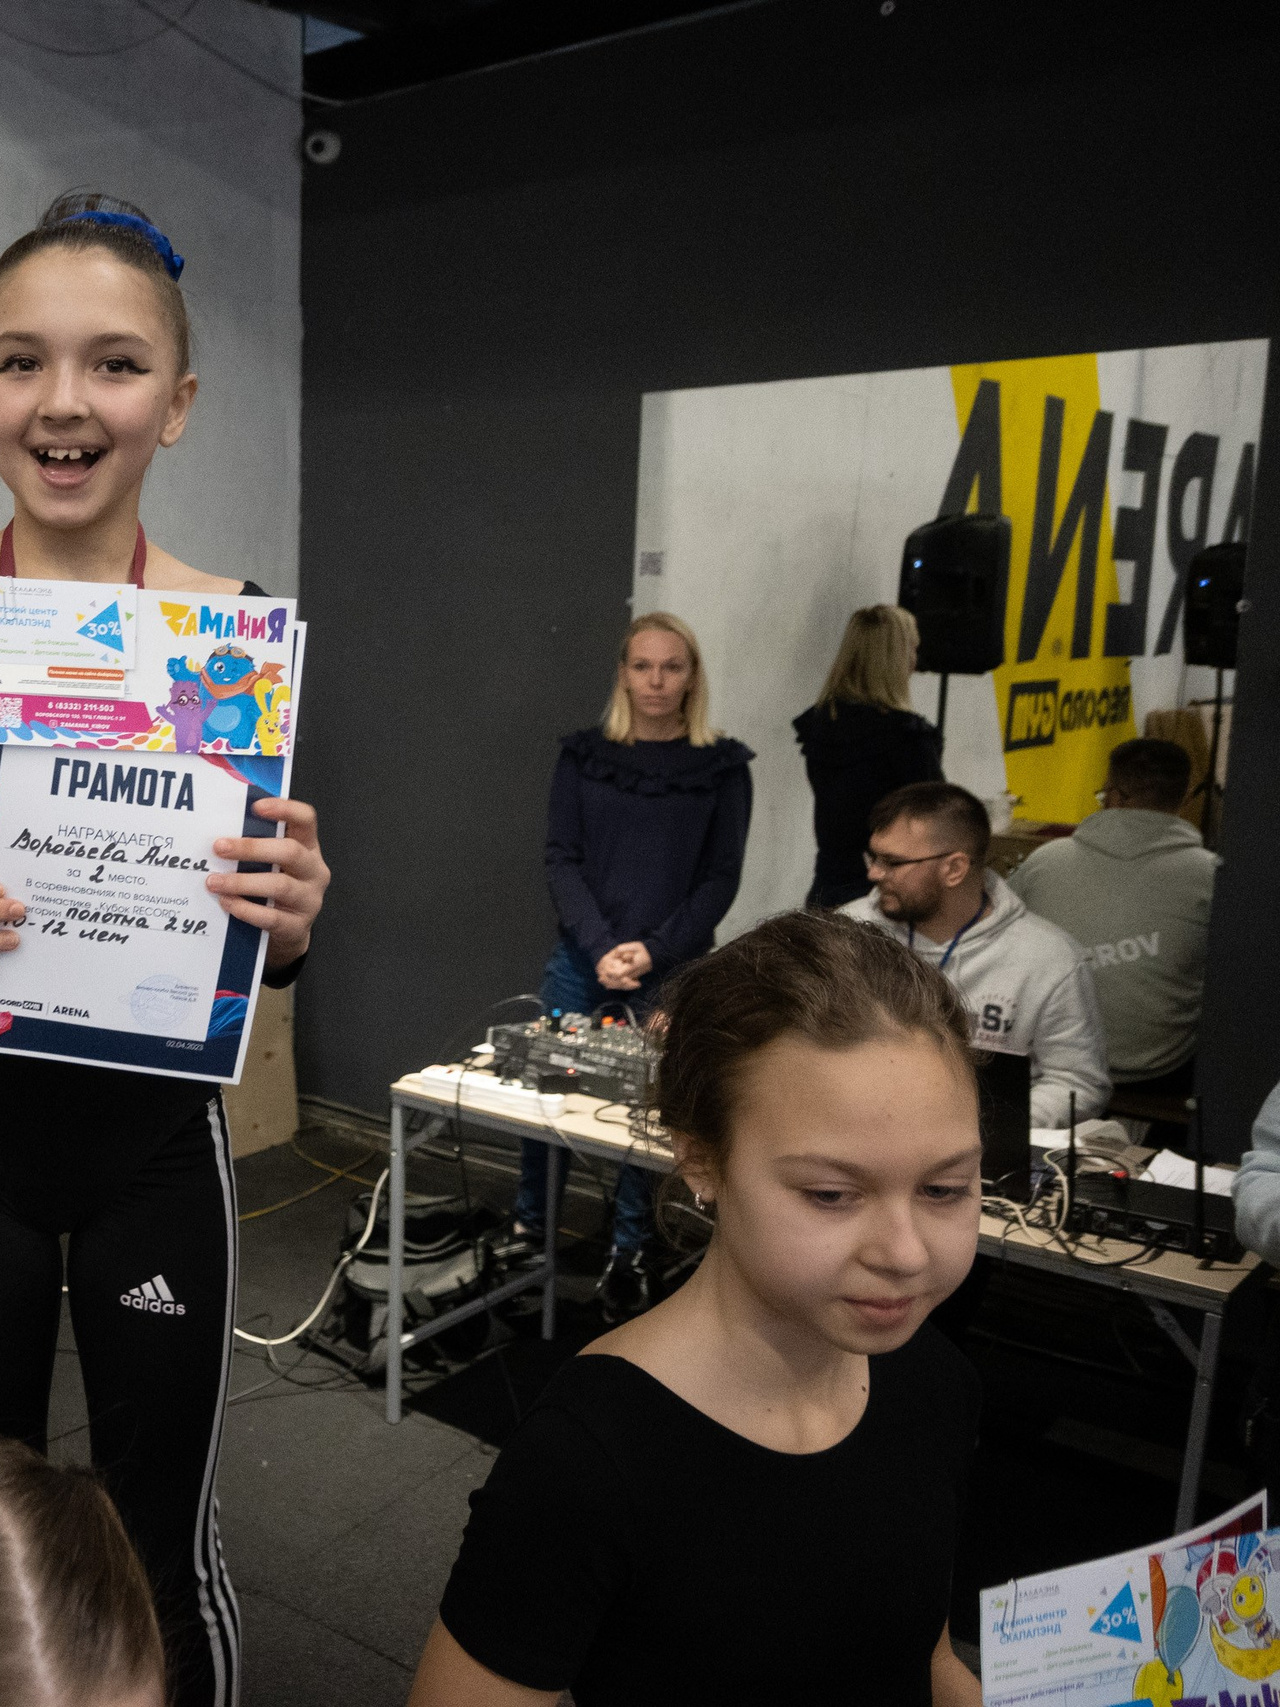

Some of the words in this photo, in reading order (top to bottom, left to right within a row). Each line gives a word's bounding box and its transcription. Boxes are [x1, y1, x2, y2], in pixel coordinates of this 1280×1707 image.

[28, 606, 59, 616] центр
[86, 621, 122, 638] 30%
[48, 701, 53, 709] 8
[55, 701, 81, 710] (8332)
[83, 702, 115, 712] 211-503
[50, 757, 194, 811] ГРАМОТА
[57, 824, 174, 850] НАГРАЖДАЕТСЯ
[10, 828, 128, 864] Воробьева
[136, 845, 210, 872] Алеся
[66, 867, 82, 878] за
[89, 864, 105, 884] 2
[108, 873, 148, 886] место.
[25, 878, 32, 887] В
[34, 880, 116, 898] соревнованиях
[118, 892, 131, 900] по
[133, 892, 189, 906] воздушной
[31, 893, 92, 909] гимнастике
[24, 905, 62, 919] егории
[163, 916, 178, 932] 2
[52, 1005, 90, 1019] ARENA
[165, 1040, 204, 1051] 02.04.2023
[120, 1294, 186, 1315] adidas
[1101, 1605, 1137, 1634] 30%
